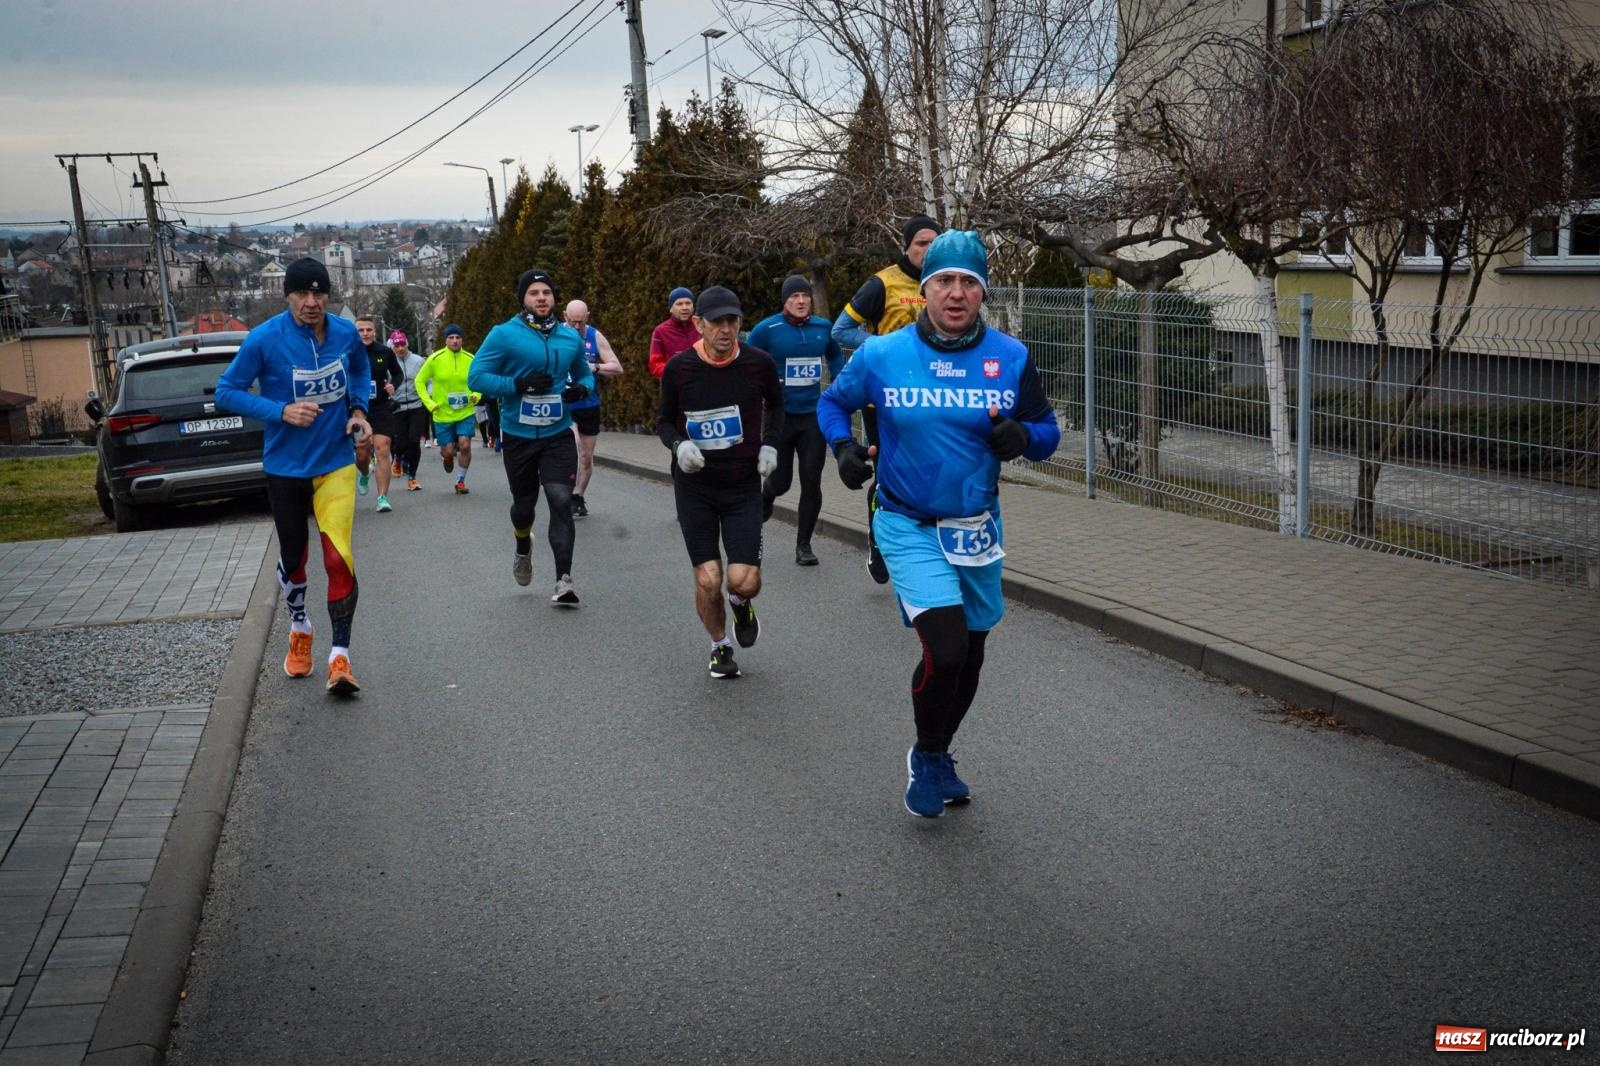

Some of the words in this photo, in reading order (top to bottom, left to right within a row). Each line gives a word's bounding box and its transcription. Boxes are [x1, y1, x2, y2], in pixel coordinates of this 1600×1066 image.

[793, 365, 816, 378] 145
[304, 374, 340, 396] 216
[883, 387, 1016, 410] RUNNERS
[531, 404, 551, 417] 50
[701, 420, 726, 438] 80
[952, 523, 992, 555] 135
